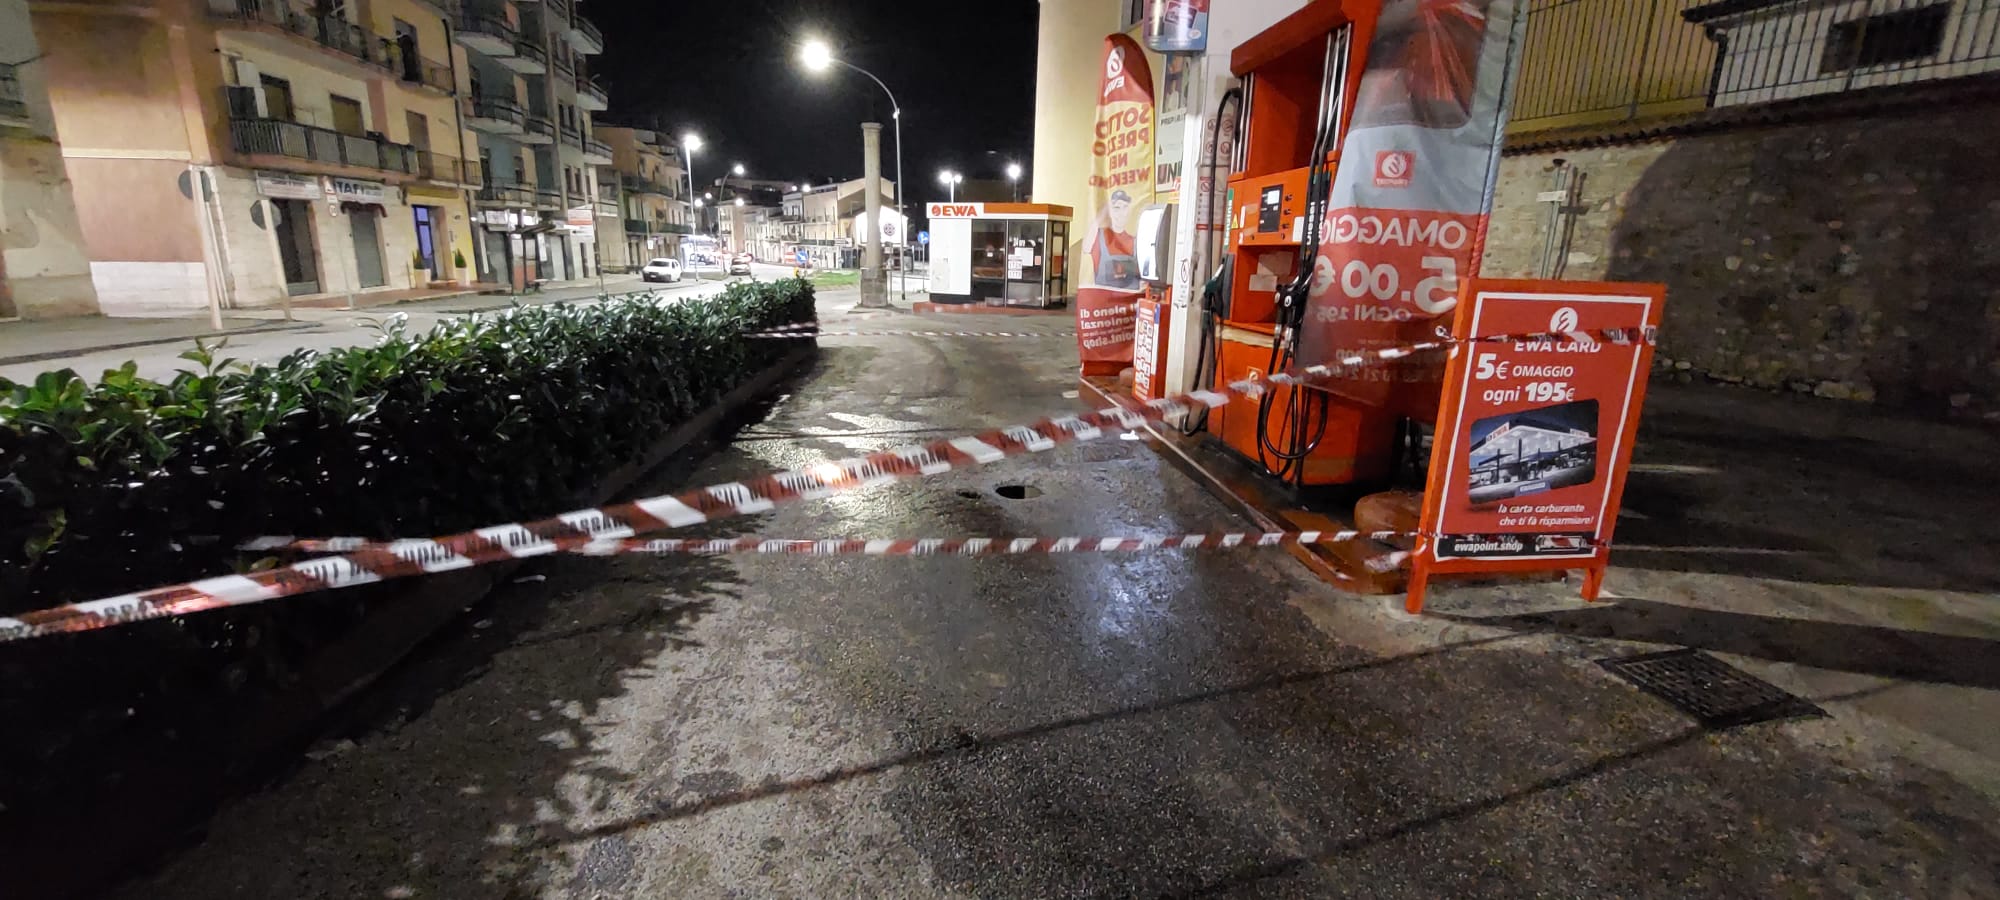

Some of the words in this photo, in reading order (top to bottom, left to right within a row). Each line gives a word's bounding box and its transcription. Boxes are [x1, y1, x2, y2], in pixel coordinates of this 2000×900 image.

[942, 205, 978, 217] EWA
[1514, 341, 1551, 353] EWA
[1556, 341, 1602, 354] CARD
[1512, 365, 1574, 378] OMAGGIO
[1483, 386, 1521, 405] ogni
[1525, 382, 1575, 402] 195€
[1498, 504, 1507, 513] la
[1510, 504, 1533, 514] carta
[1535, 504, 1585, 514] carburante
[1499, 516, 1516, 526] che
[1539, 516, 1594, 529] risparmiare!
